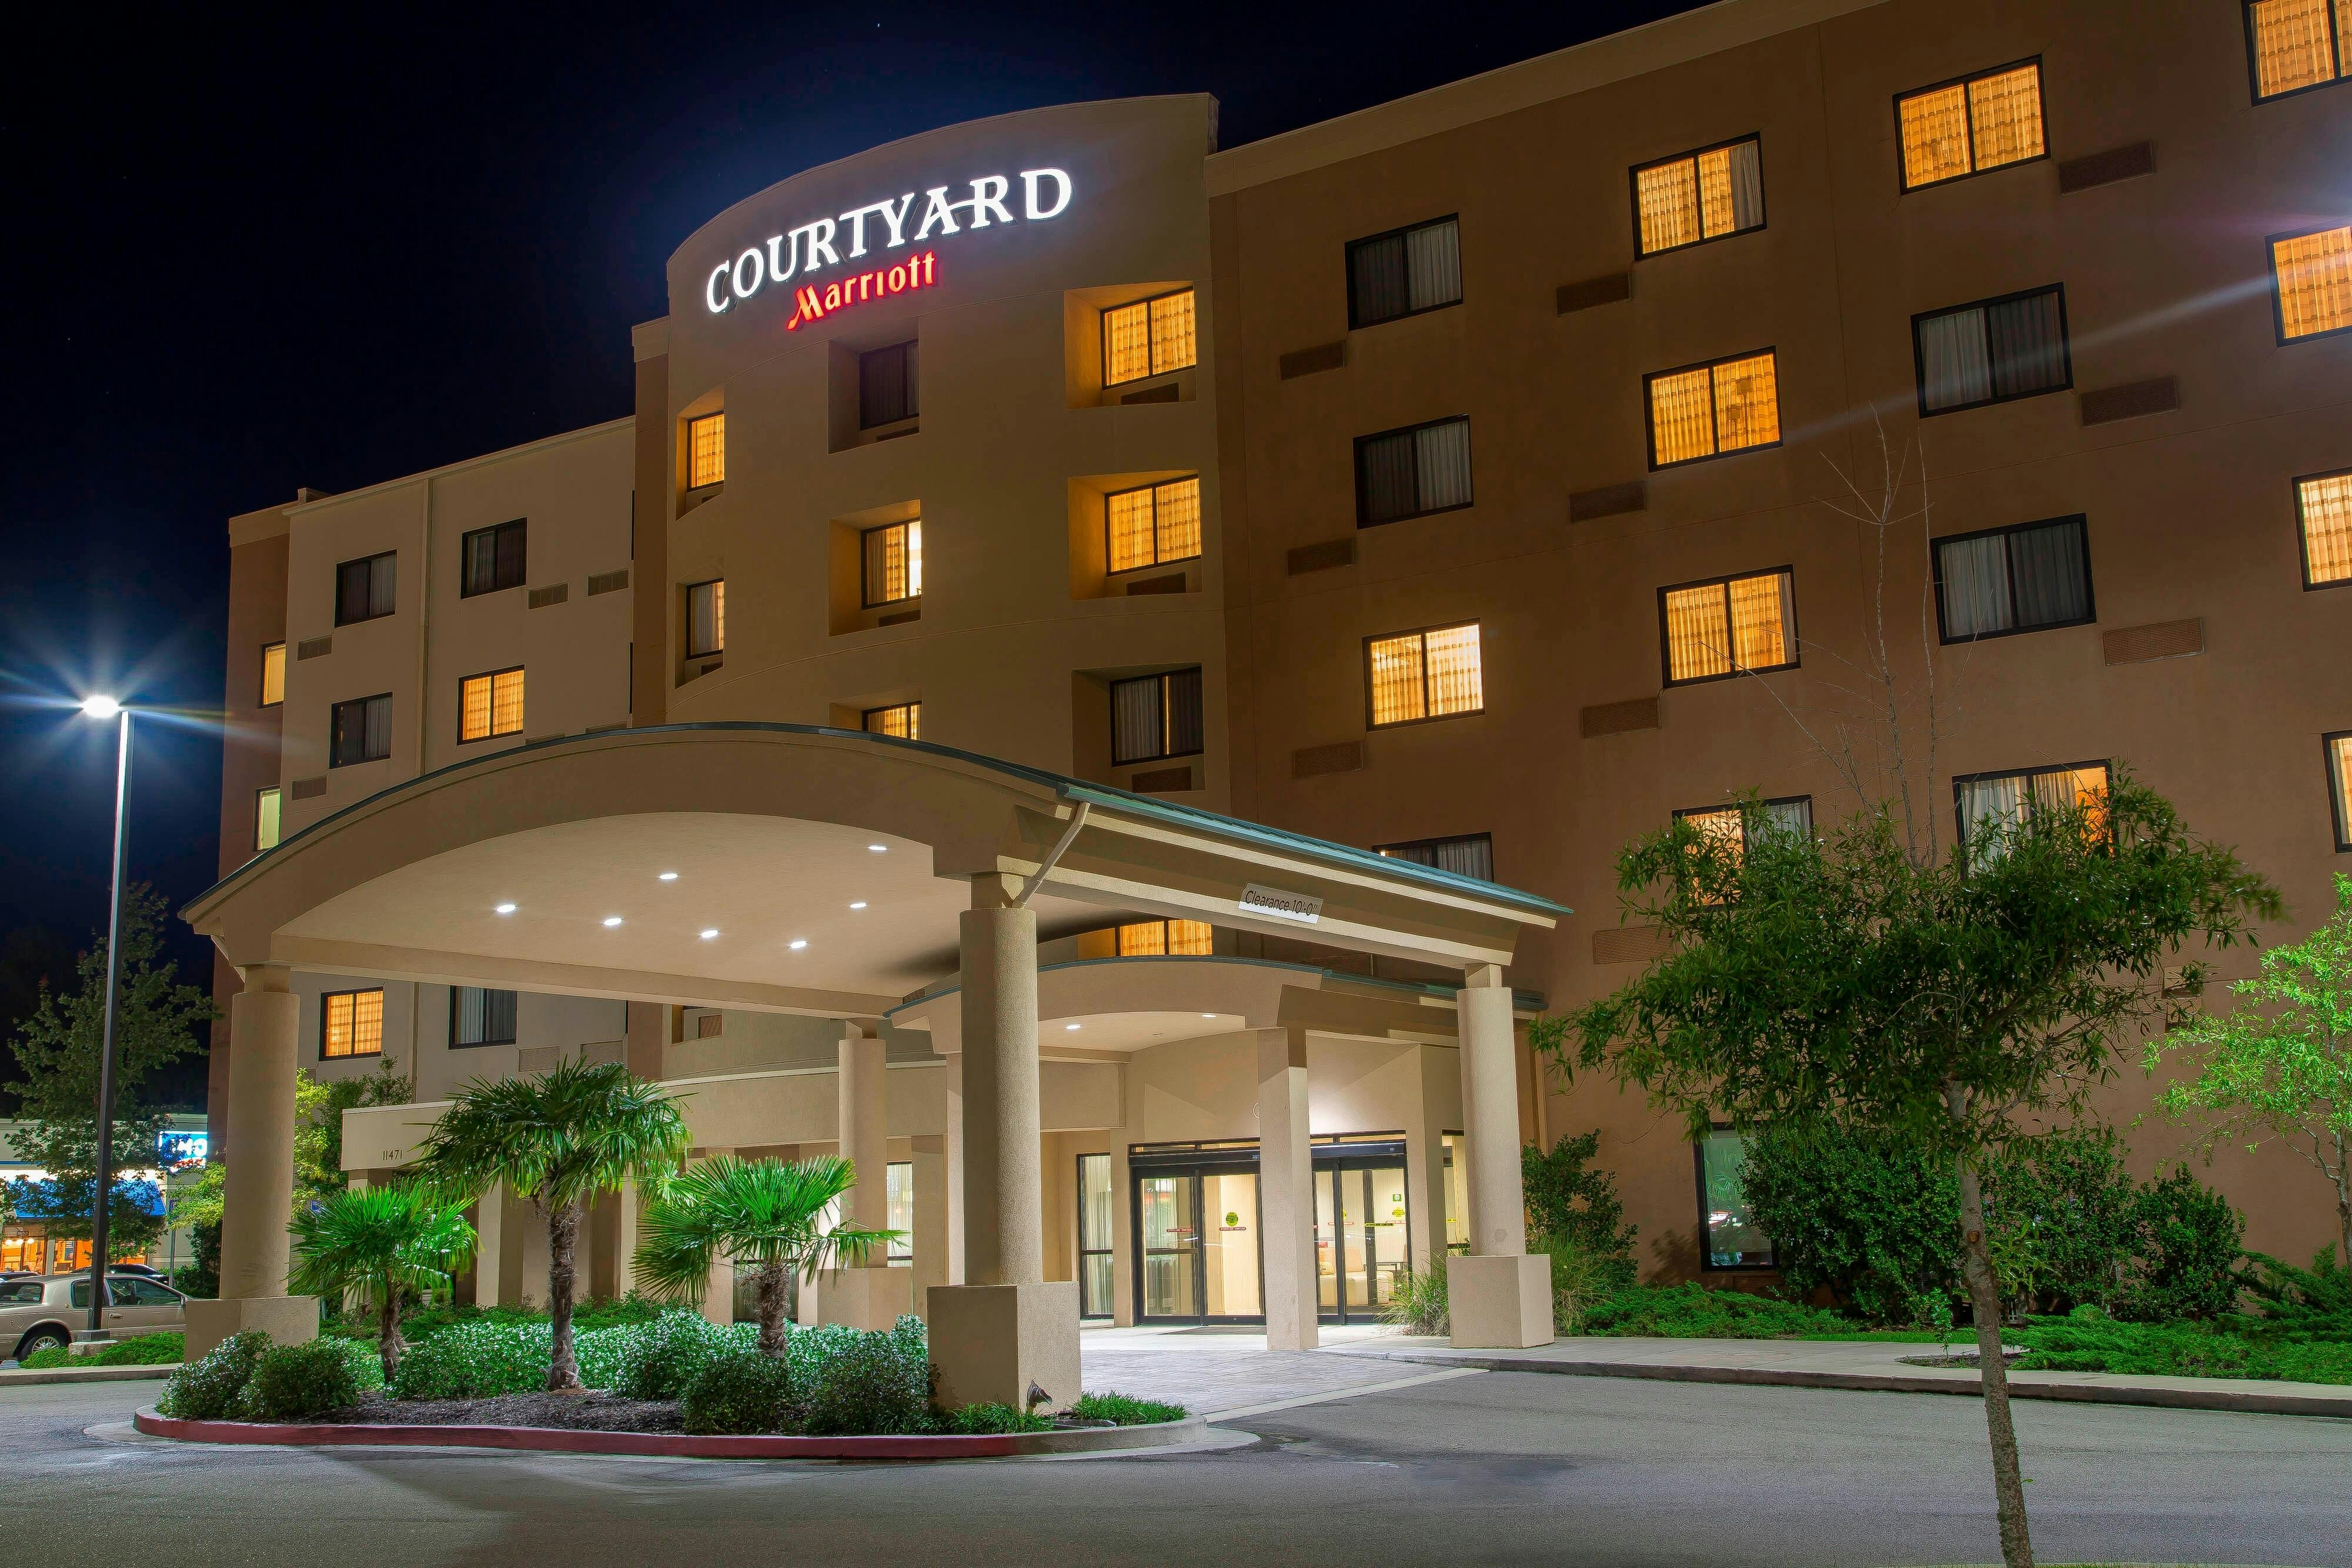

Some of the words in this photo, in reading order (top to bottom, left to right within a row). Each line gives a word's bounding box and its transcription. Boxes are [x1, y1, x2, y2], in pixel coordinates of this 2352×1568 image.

[706, 167, 1072, 314] COURTYARD
[786, 250, 936, 331] Marriott
[1245, 890, 1289, 911] Clearance
[382, 1149, 403, 1161] 11471
